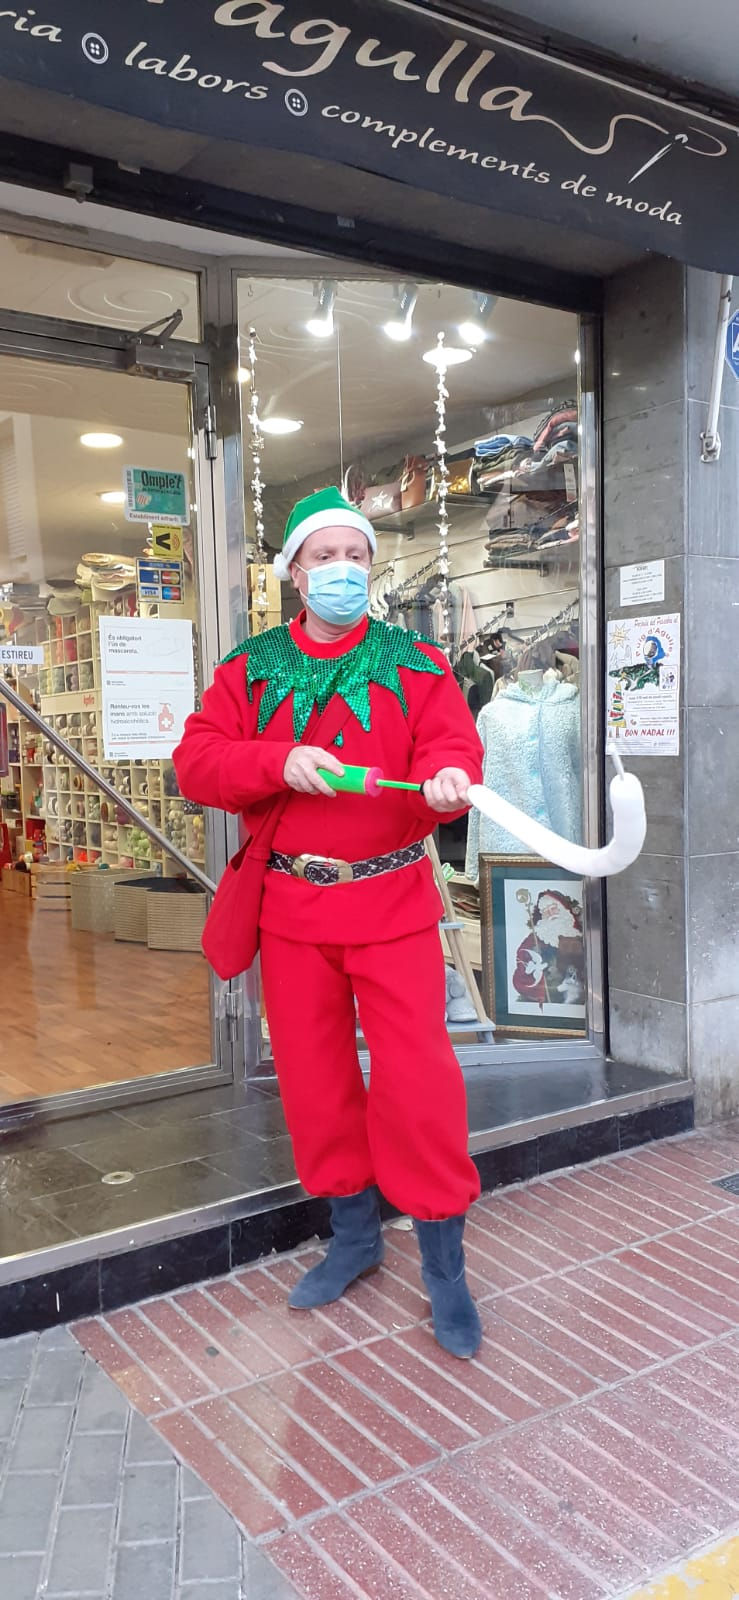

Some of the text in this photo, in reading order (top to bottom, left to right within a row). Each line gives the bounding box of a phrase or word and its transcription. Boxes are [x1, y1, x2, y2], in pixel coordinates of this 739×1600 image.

[124, 42, 268, 99] labors
[321, 105, 550, 183] complements
[560, 174, 597, 197] de
[606, 191, 682, 225] moda
[2, 650, 33, 660] ESTIREU
[625, 729, 638, 737] BON
[641, 729, 664, 737] NADAL
